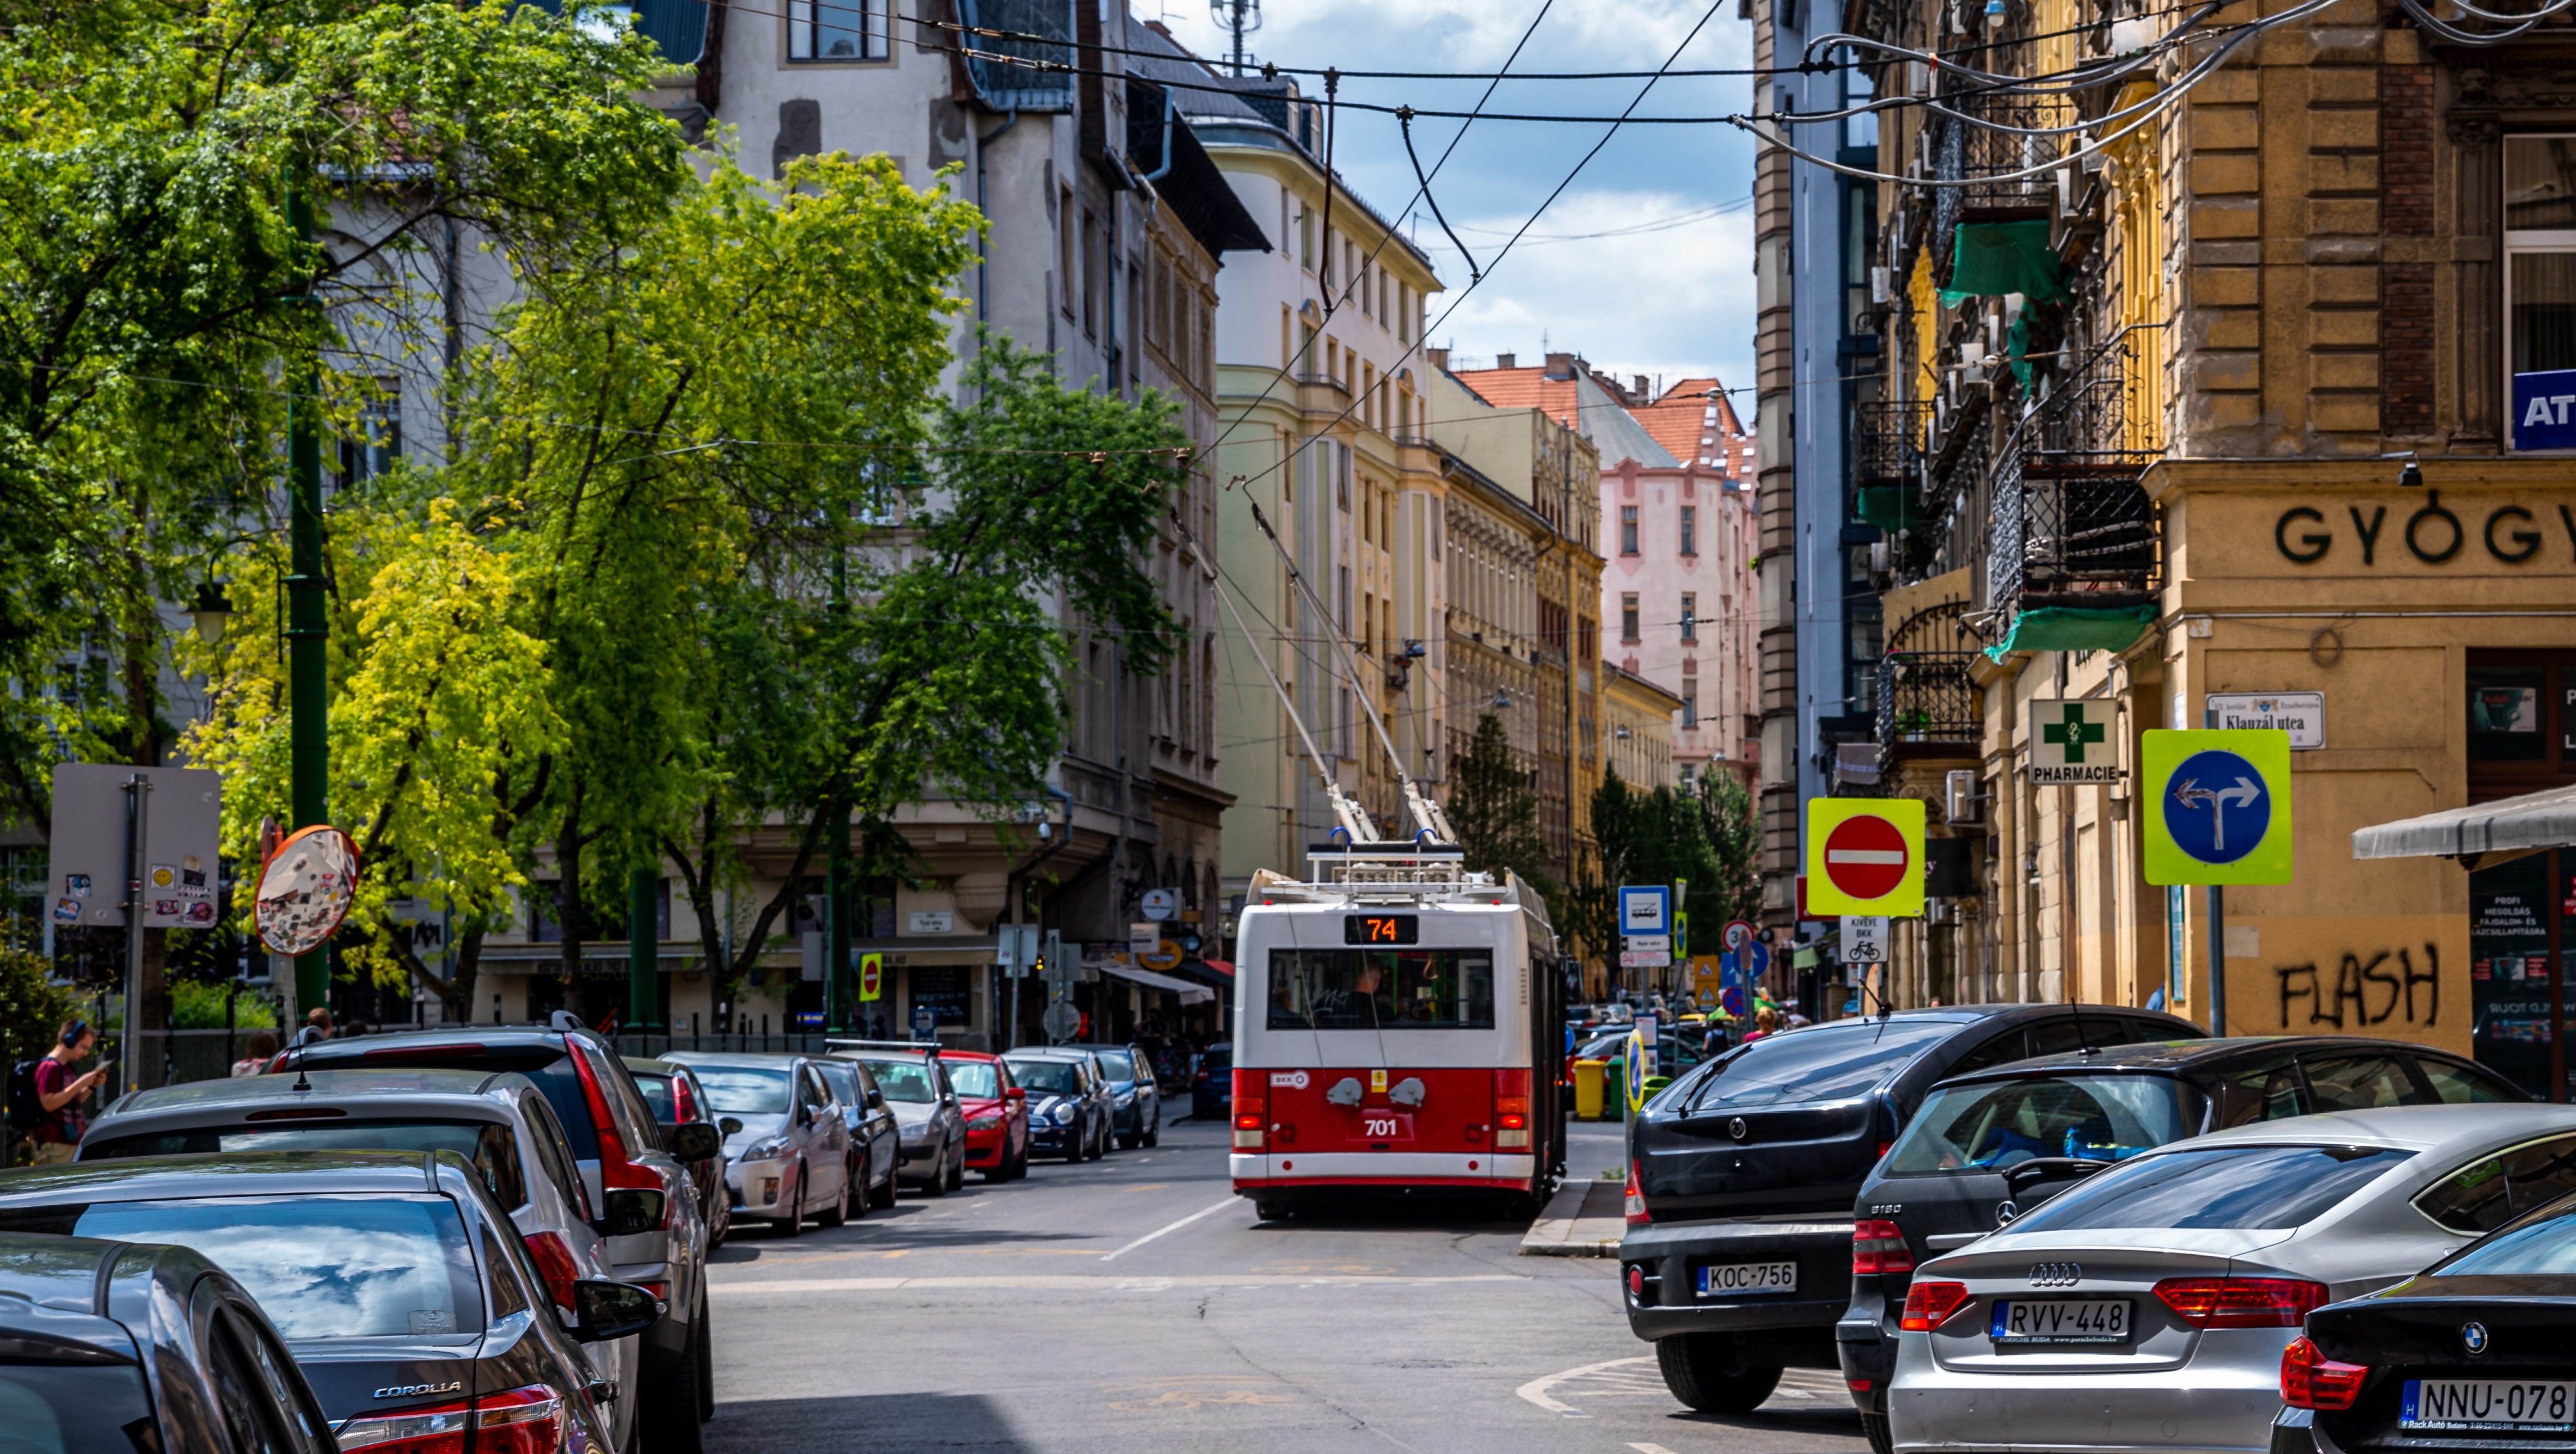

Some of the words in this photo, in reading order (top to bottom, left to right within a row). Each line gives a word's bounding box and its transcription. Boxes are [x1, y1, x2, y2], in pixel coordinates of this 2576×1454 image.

[2226, 714, 2274, 729] Klauzál
[2277, 717, 2305, 730] utca
[2034, 766, 2117, 781] PHARMACIE
[2495, 897, 2520, 905] PROFI
[2484, 906, 2531, 916] MEGOLDÁS
[1851, 916, 1878, 927] KIVÉVE
[2526, 917, 2537, 925] ÉS
[1366, 919, 1396, 941] 74
[1856, 929, 1873, 937] BKK
[2277, 942, 2439, 1029] FLASH
[1364, 1119, 1396, 1136] 701
[1711, 1264, 1792, 1289] KOC-756
[2011, 1304, 2123, 1332] RVV-448
[373, 1381, 462, 1399] COROLLA
[2406, 1403, 2414, 1415] H
[2424, 1384, 2567, 1420] NNU-078
[2408, 1420, 2427, 1429] Rack
[2427, 1420, 2446, 1429] Autó
